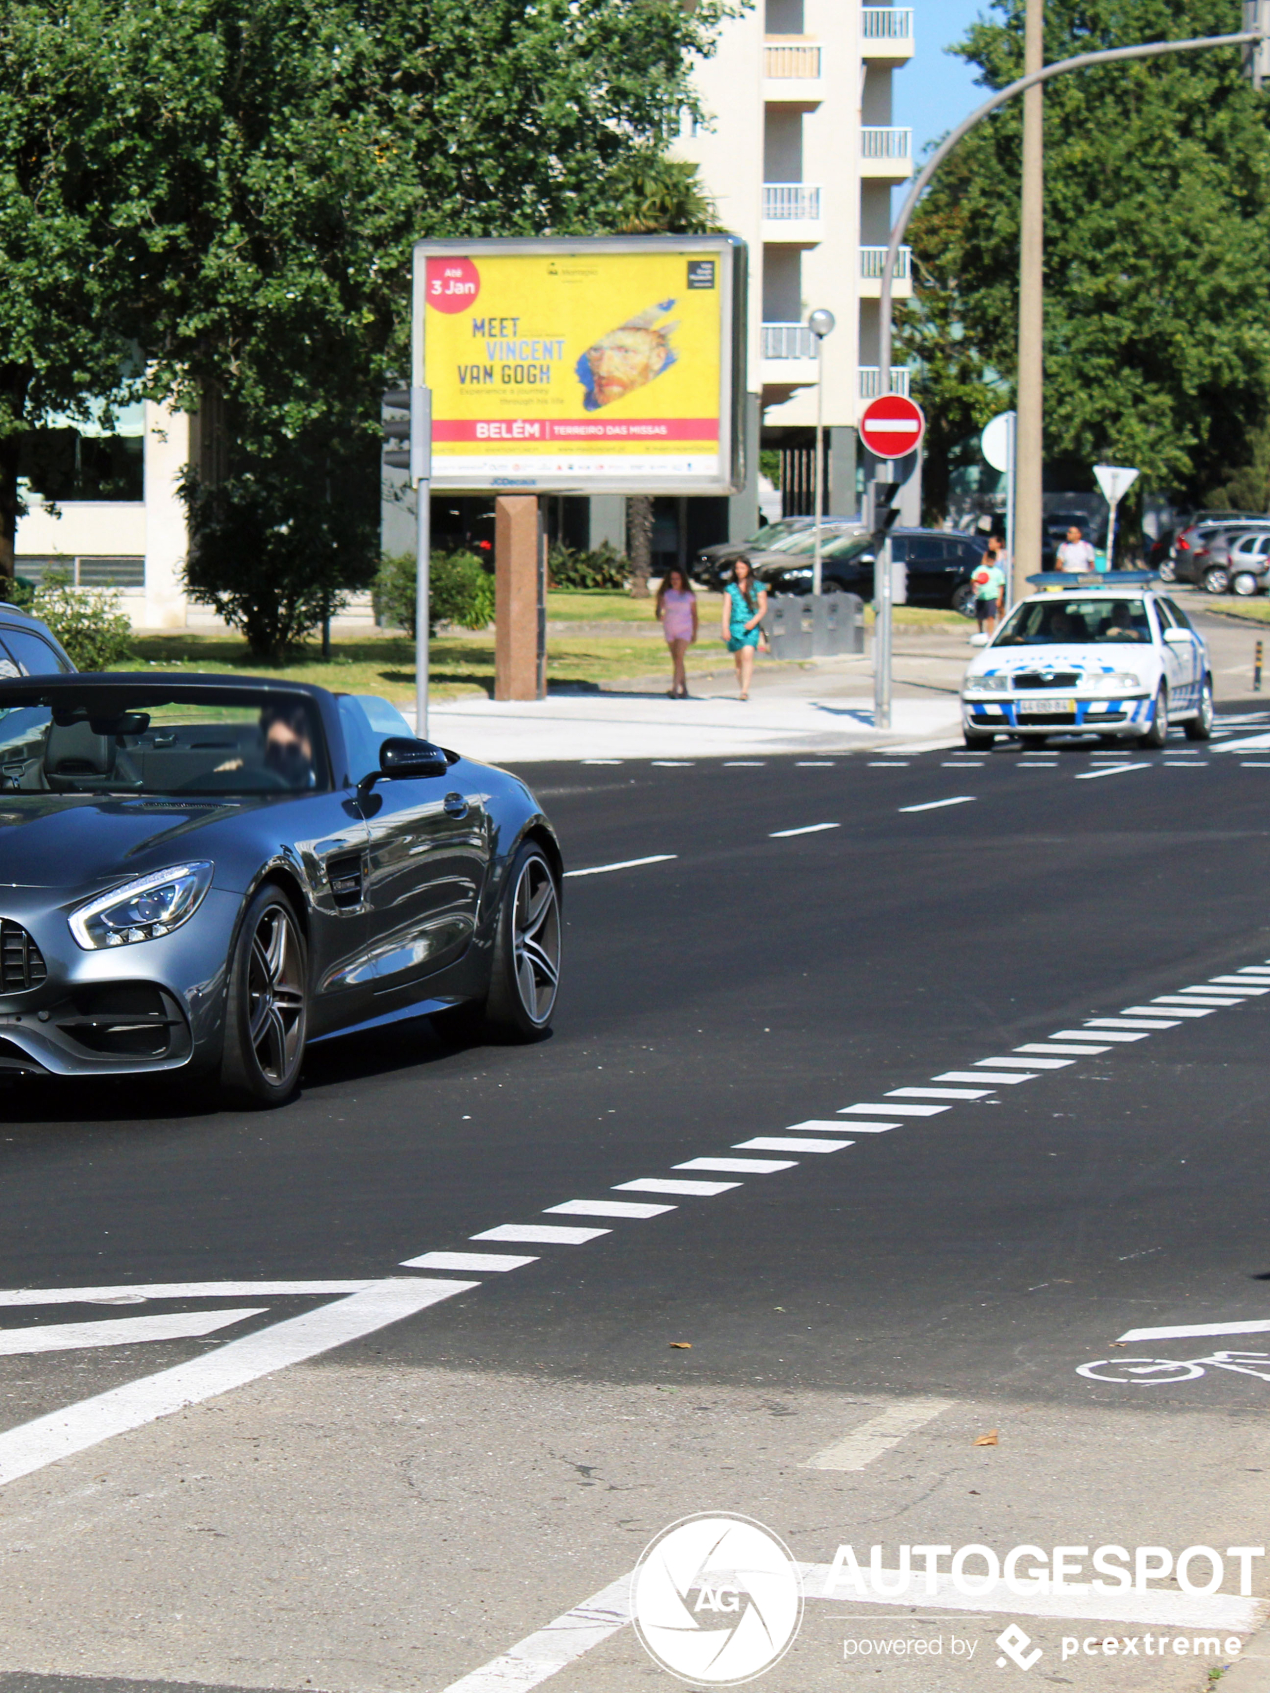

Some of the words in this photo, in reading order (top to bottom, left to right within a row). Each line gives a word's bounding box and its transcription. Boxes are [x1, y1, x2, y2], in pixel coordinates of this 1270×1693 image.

[431, 280, 442, 295] 3
[444, 280, 476, 295] Jan
[472, 317, 520, 338] MEET
[486, 339, 566, 361] VINCENT
[457, 364, 494, 384] VAN
[501, 364, 551, 384] GOGH
[476, 418, 540, 438] BELÉM
[553, 425, 605, 436] TERREIRO
[606, 425, 628, 436] DAS
[629, 425, 667, 435] MISSAS
